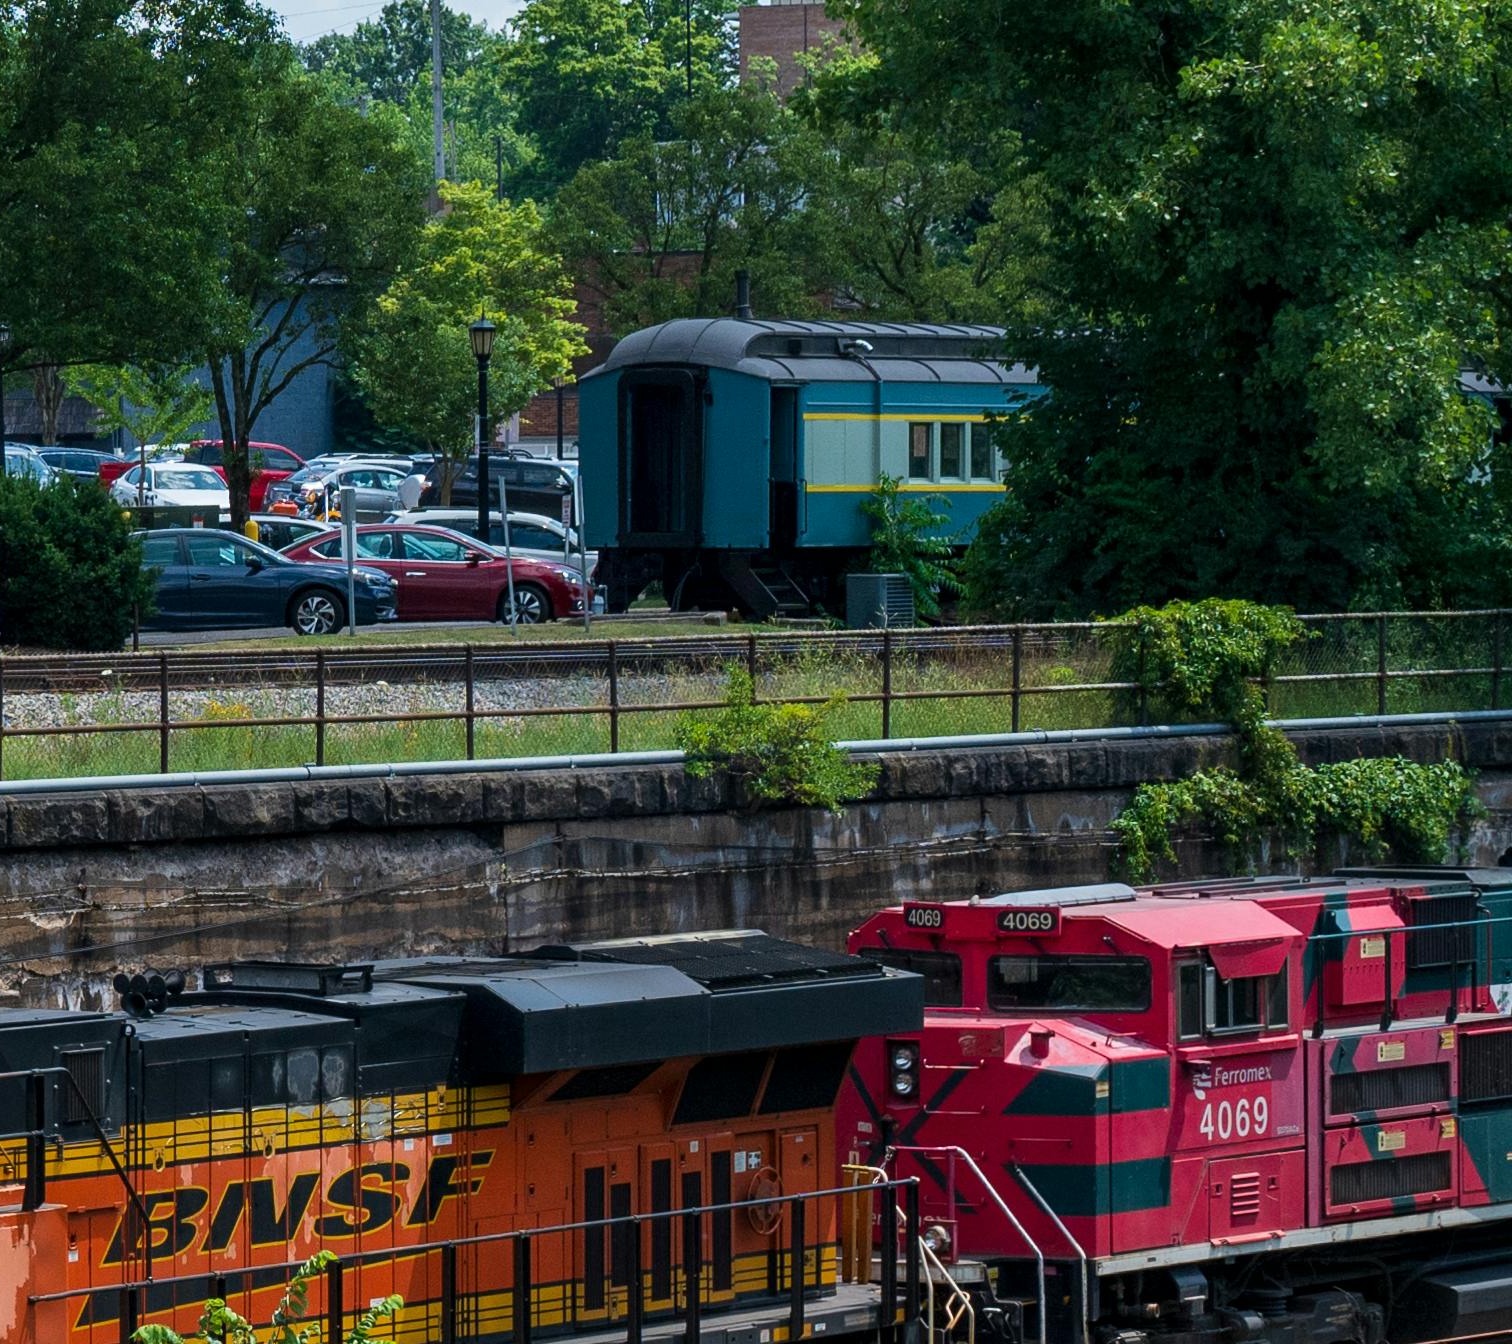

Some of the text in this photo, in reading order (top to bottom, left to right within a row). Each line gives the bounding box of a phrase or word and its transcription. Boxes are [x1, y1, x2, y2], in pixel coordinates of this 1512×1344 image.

[908, 909, 941, 927] 4069
[1003, 912, 1052, 930] 4069
[1215, 1066, 1272, 1086] Ferromex
[1200, 1096, 1268, 1141] 4069
[99, 1148, 497, 1269] BNSF
